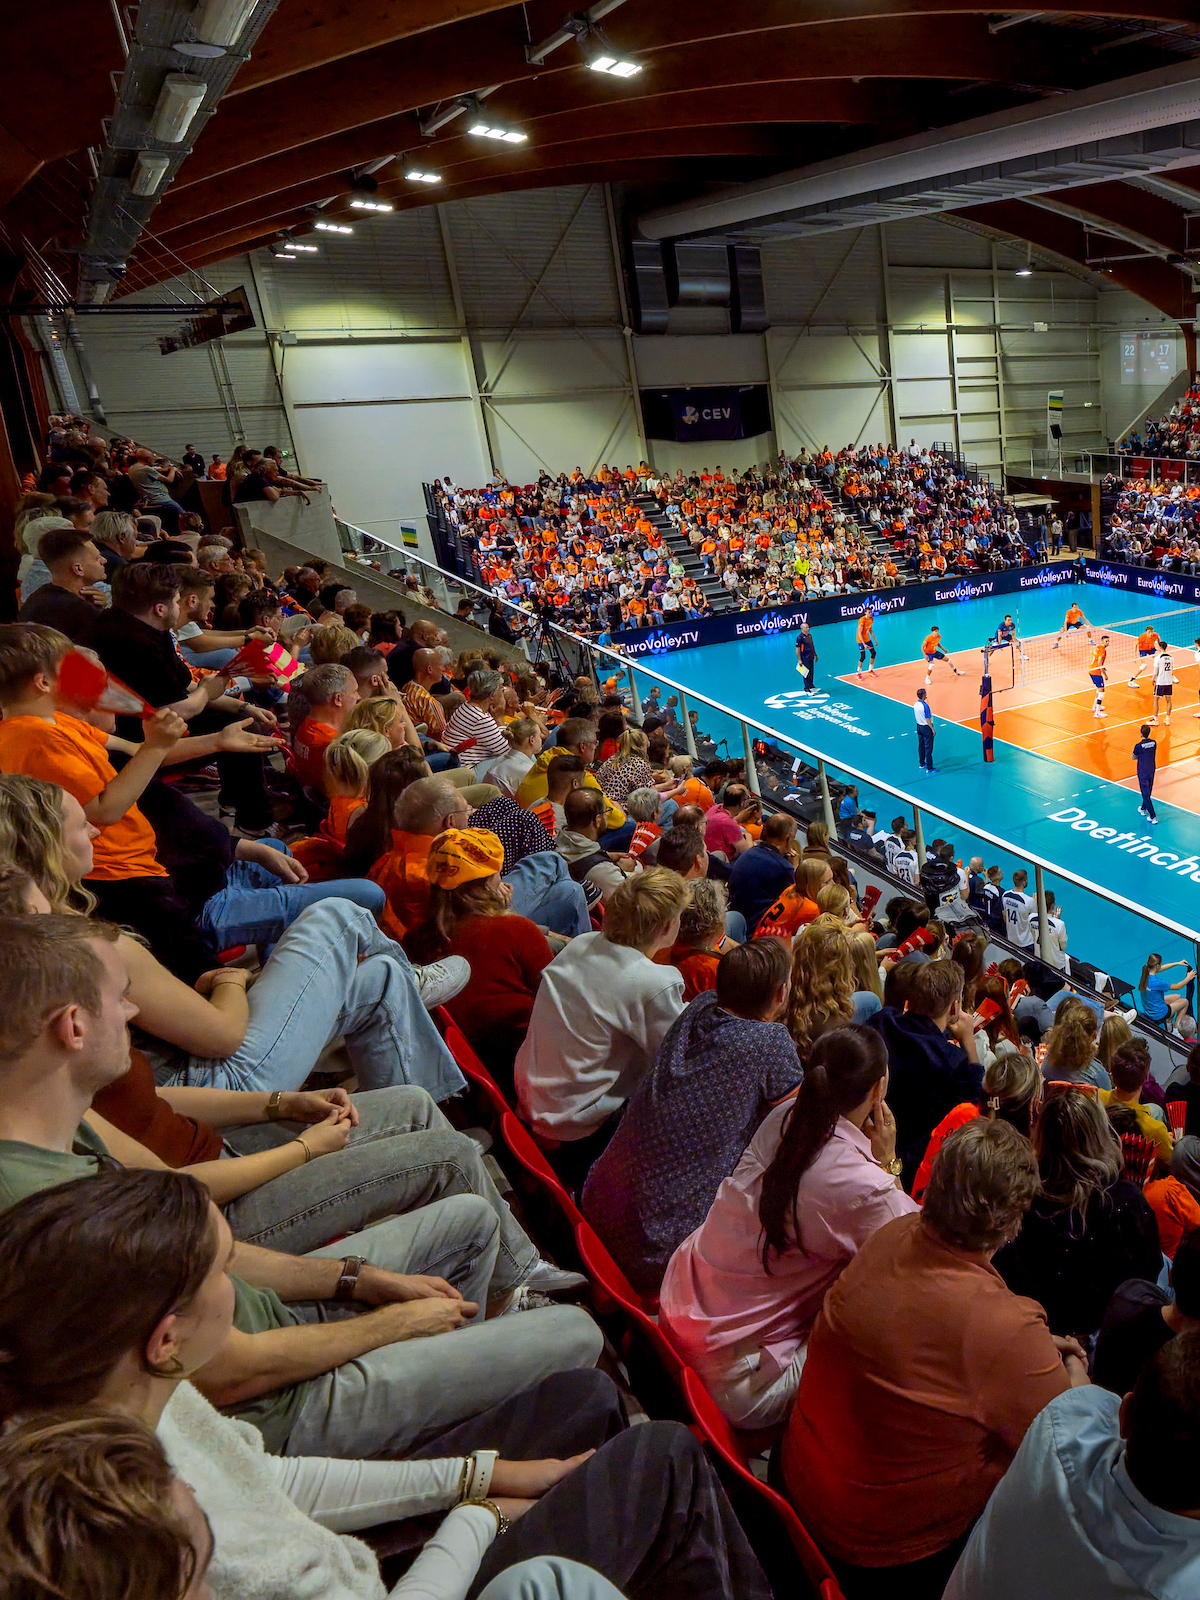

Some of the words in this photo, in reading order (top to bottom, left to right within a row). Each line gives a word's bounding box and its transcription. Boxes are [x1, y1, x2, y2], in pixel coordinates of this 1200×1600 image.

[1125, 344, 1134, 356] 22
[1159, 344, 1169, 356] 17
[702, 408, 731, 420] CEV
[1020, 570, 1072, 587] EuroVolley.TV
[1085, 568, 1128, 584] EuroVolley.TV
[935, 582, 993, 601] EuroVolley.TV
[1137, 577, 1184, 595] EuroVolley.TV
[736, 613, 808, 635] EuroVolley.TV
[1164, 662, 1171, 671] 22
[1007, 908, 1018, 924] 14
